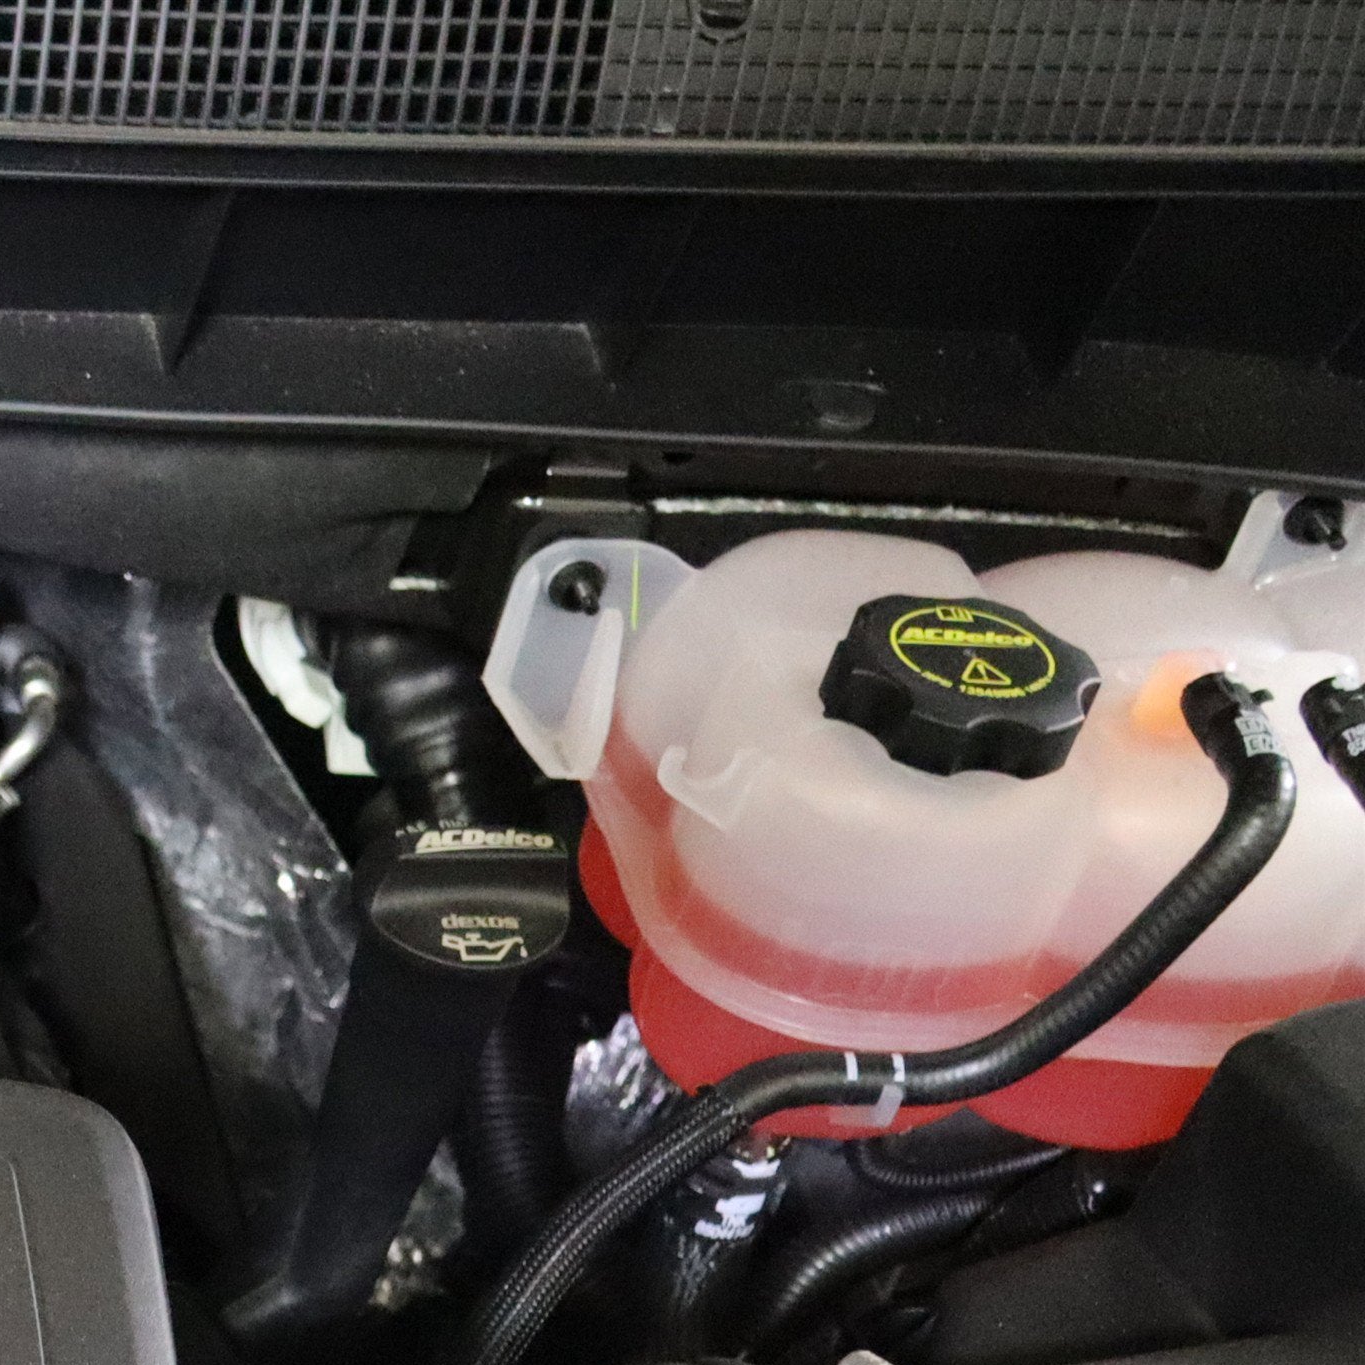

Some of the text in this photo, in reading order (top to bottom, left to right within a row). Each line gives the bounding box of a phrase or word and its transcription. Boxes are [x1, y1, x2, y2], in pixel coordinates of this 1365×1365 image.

[898, 627, 1034, 647] ACDelco
[416, 828, 554, 853] ACDelco
[440, 914, 519, 930] dexos
